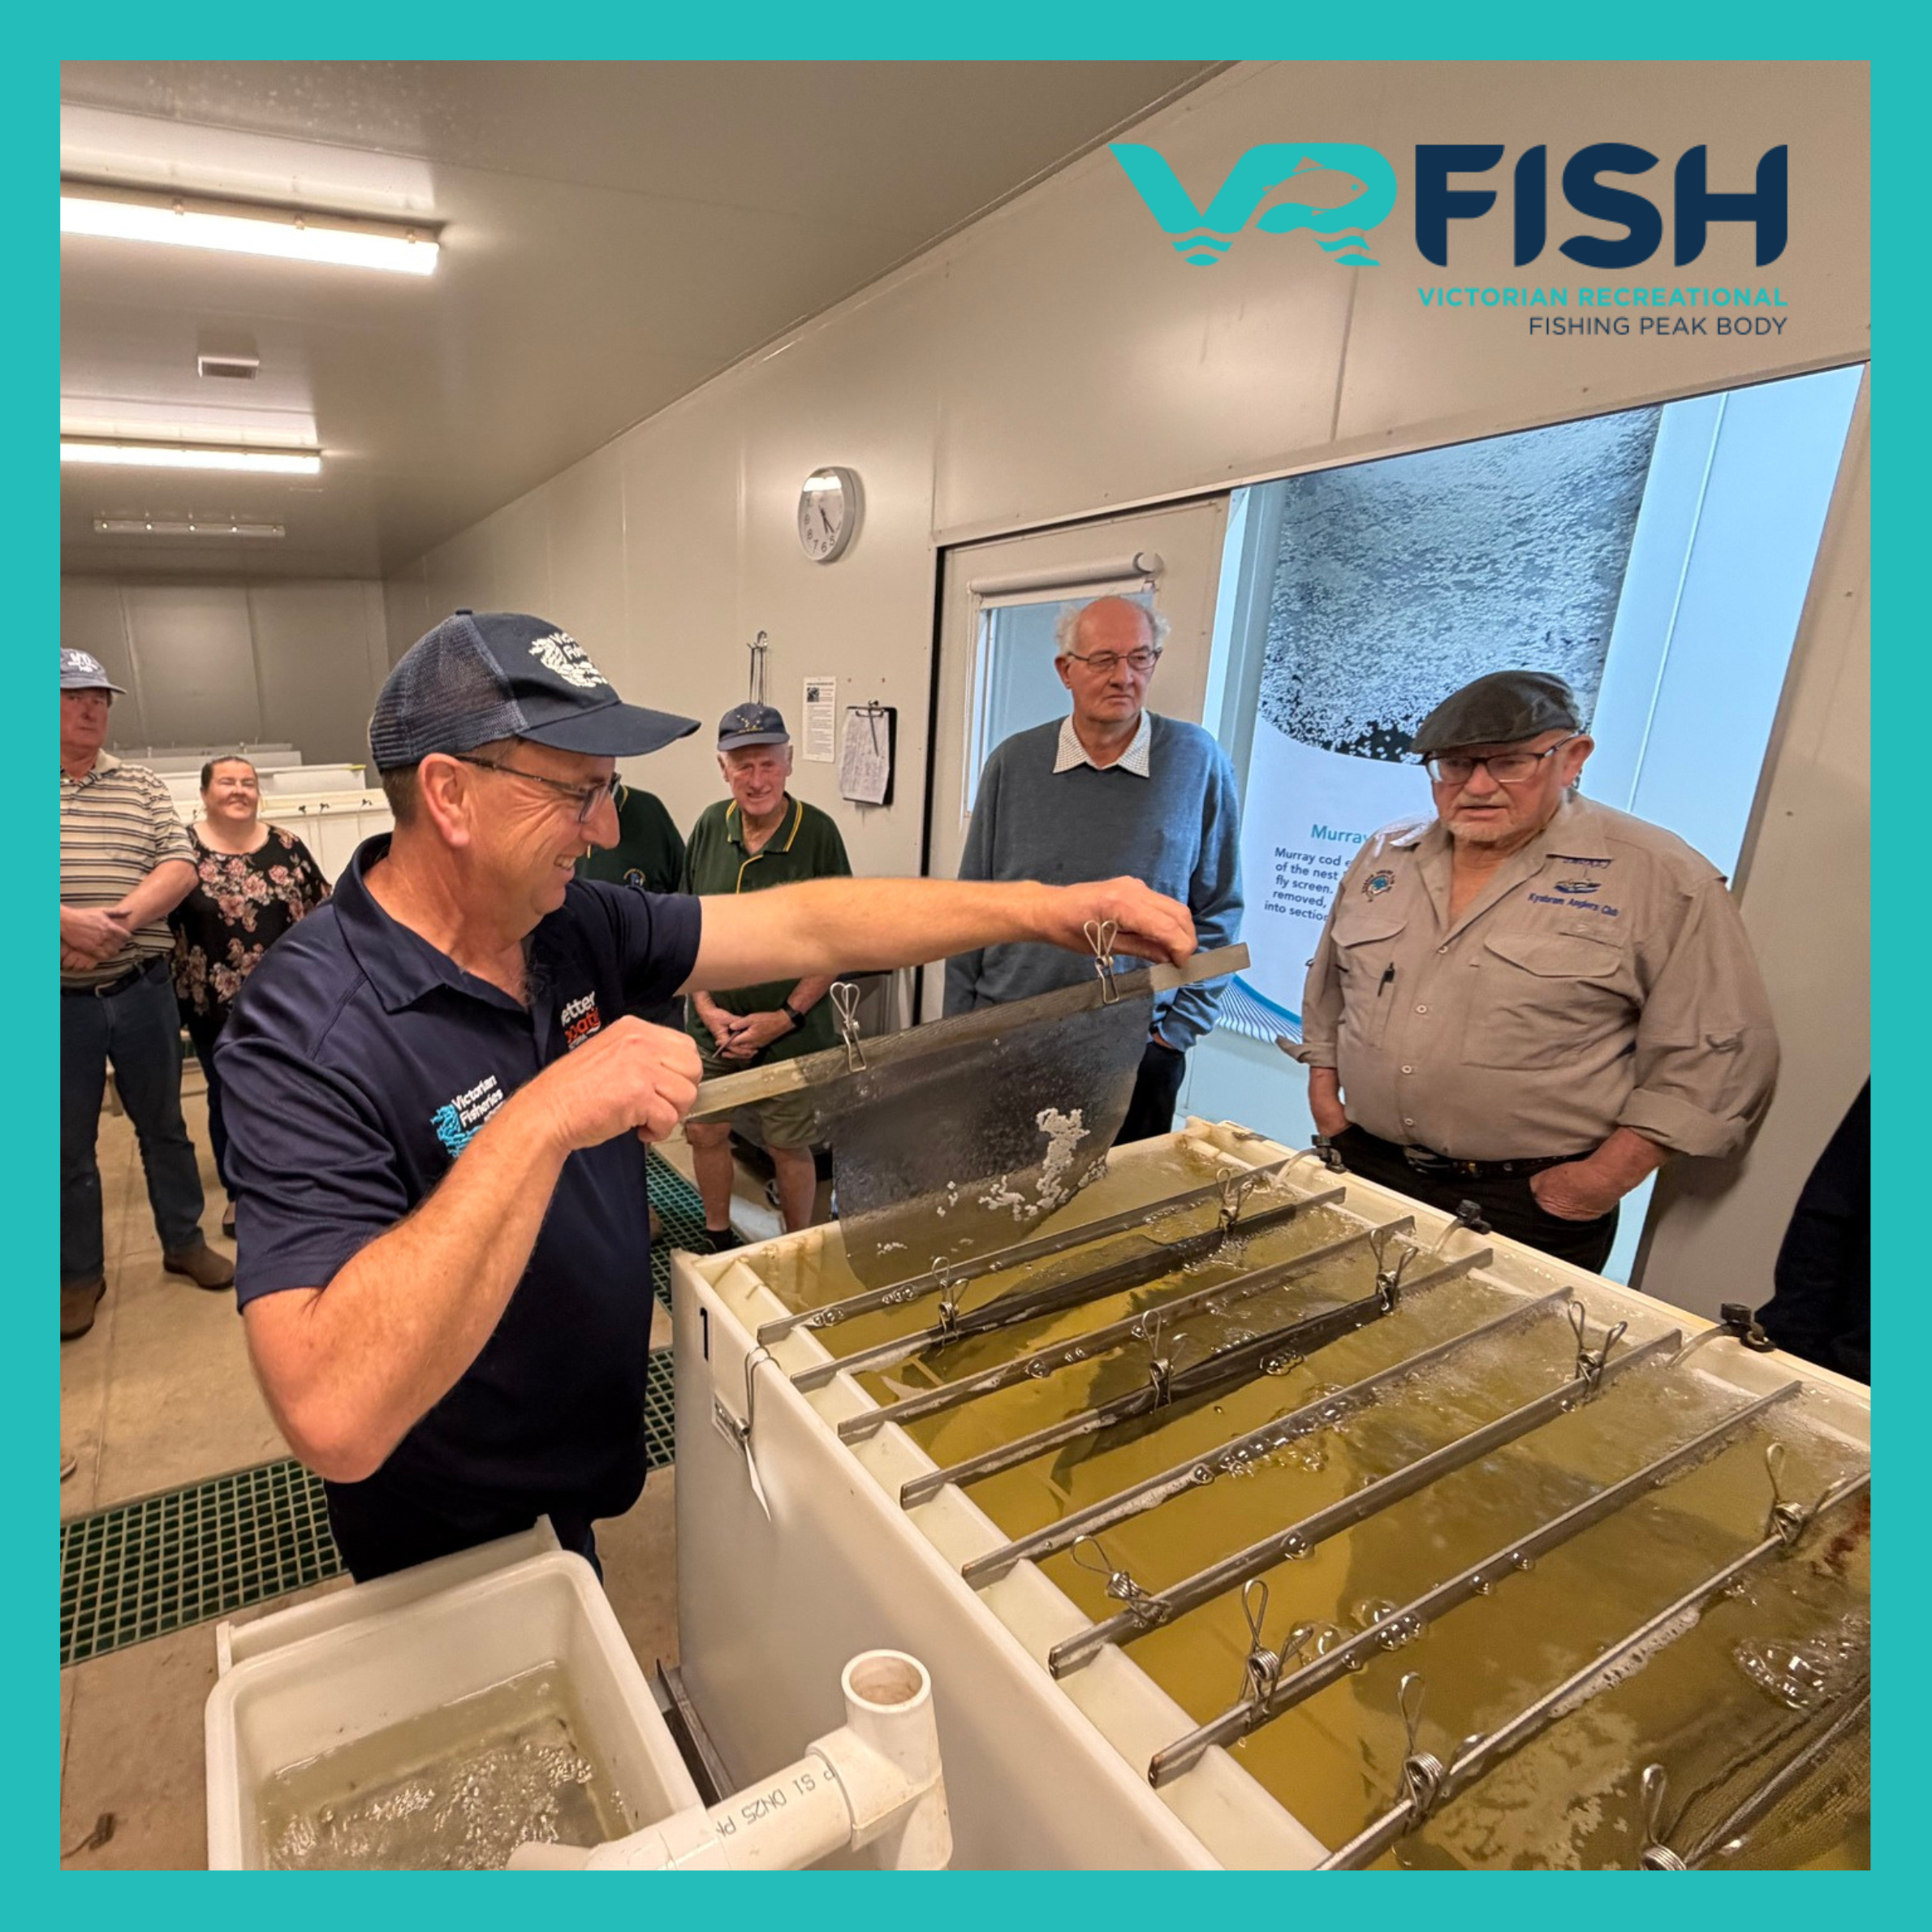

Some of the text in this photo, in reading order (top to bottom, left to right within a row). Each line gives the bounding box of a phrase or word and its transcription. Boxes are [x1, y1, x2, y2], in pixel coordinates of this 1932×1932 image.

[1274, 847, 1316, 865] Murray
[1318, 855, 1342, 866] cod
[1275, 861, 1339, 881] of the nest
[1275, 874, 1334, 894] fly screen.
[1264, 900, 1287, 913] into
[1273, 891, 1327, 908] removed,
[560, 991, 595, 1027] etter
[451, 1075, 498, 1110] Victorian
[459, 1089, 503, 1128] Fisheries
[700, 1307, 709, 1362] 1
[741, 1788, 787, 1825] DN25
